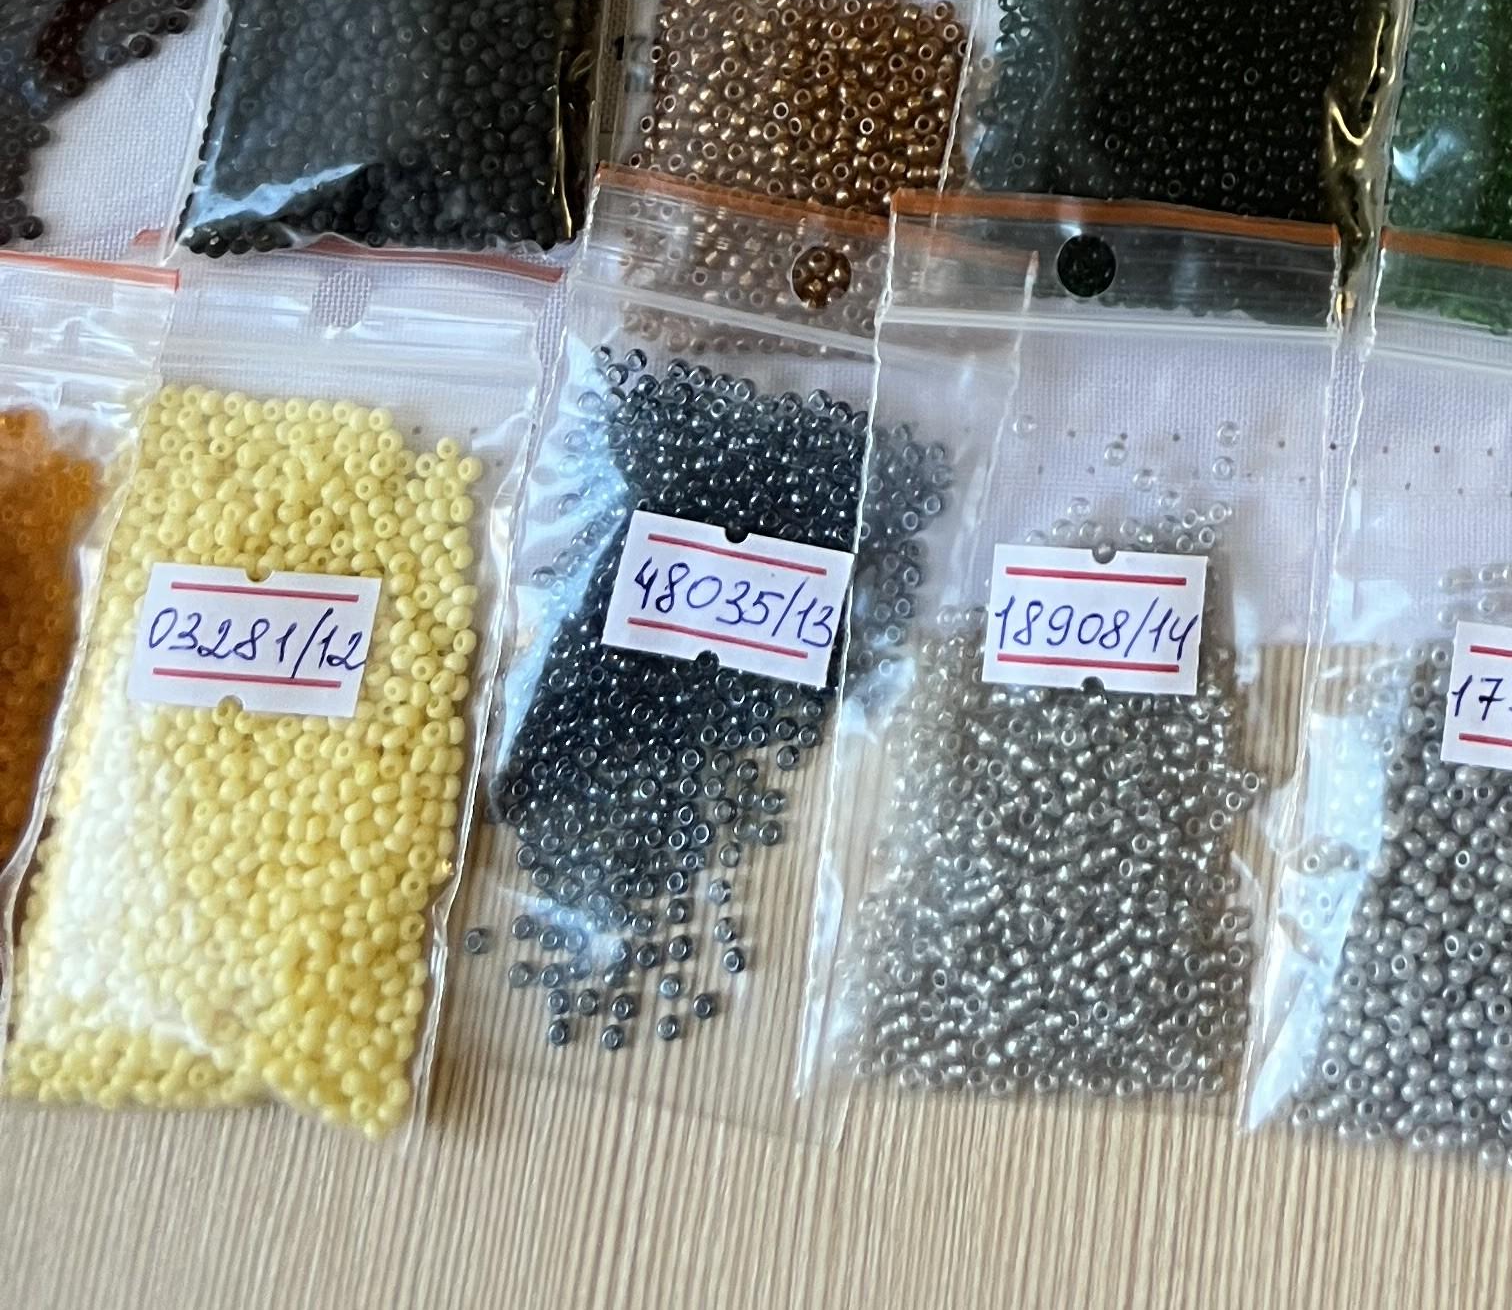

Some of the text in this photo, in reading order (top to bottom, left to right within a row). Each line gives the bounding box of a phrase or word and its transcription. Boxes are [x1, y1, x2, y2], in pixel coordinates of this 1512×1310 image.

[632, 558, 836, 650] 48035/13
[994, 596, 1199, 661] 18908/14
[148, 607, 367, 679] 03281/12
